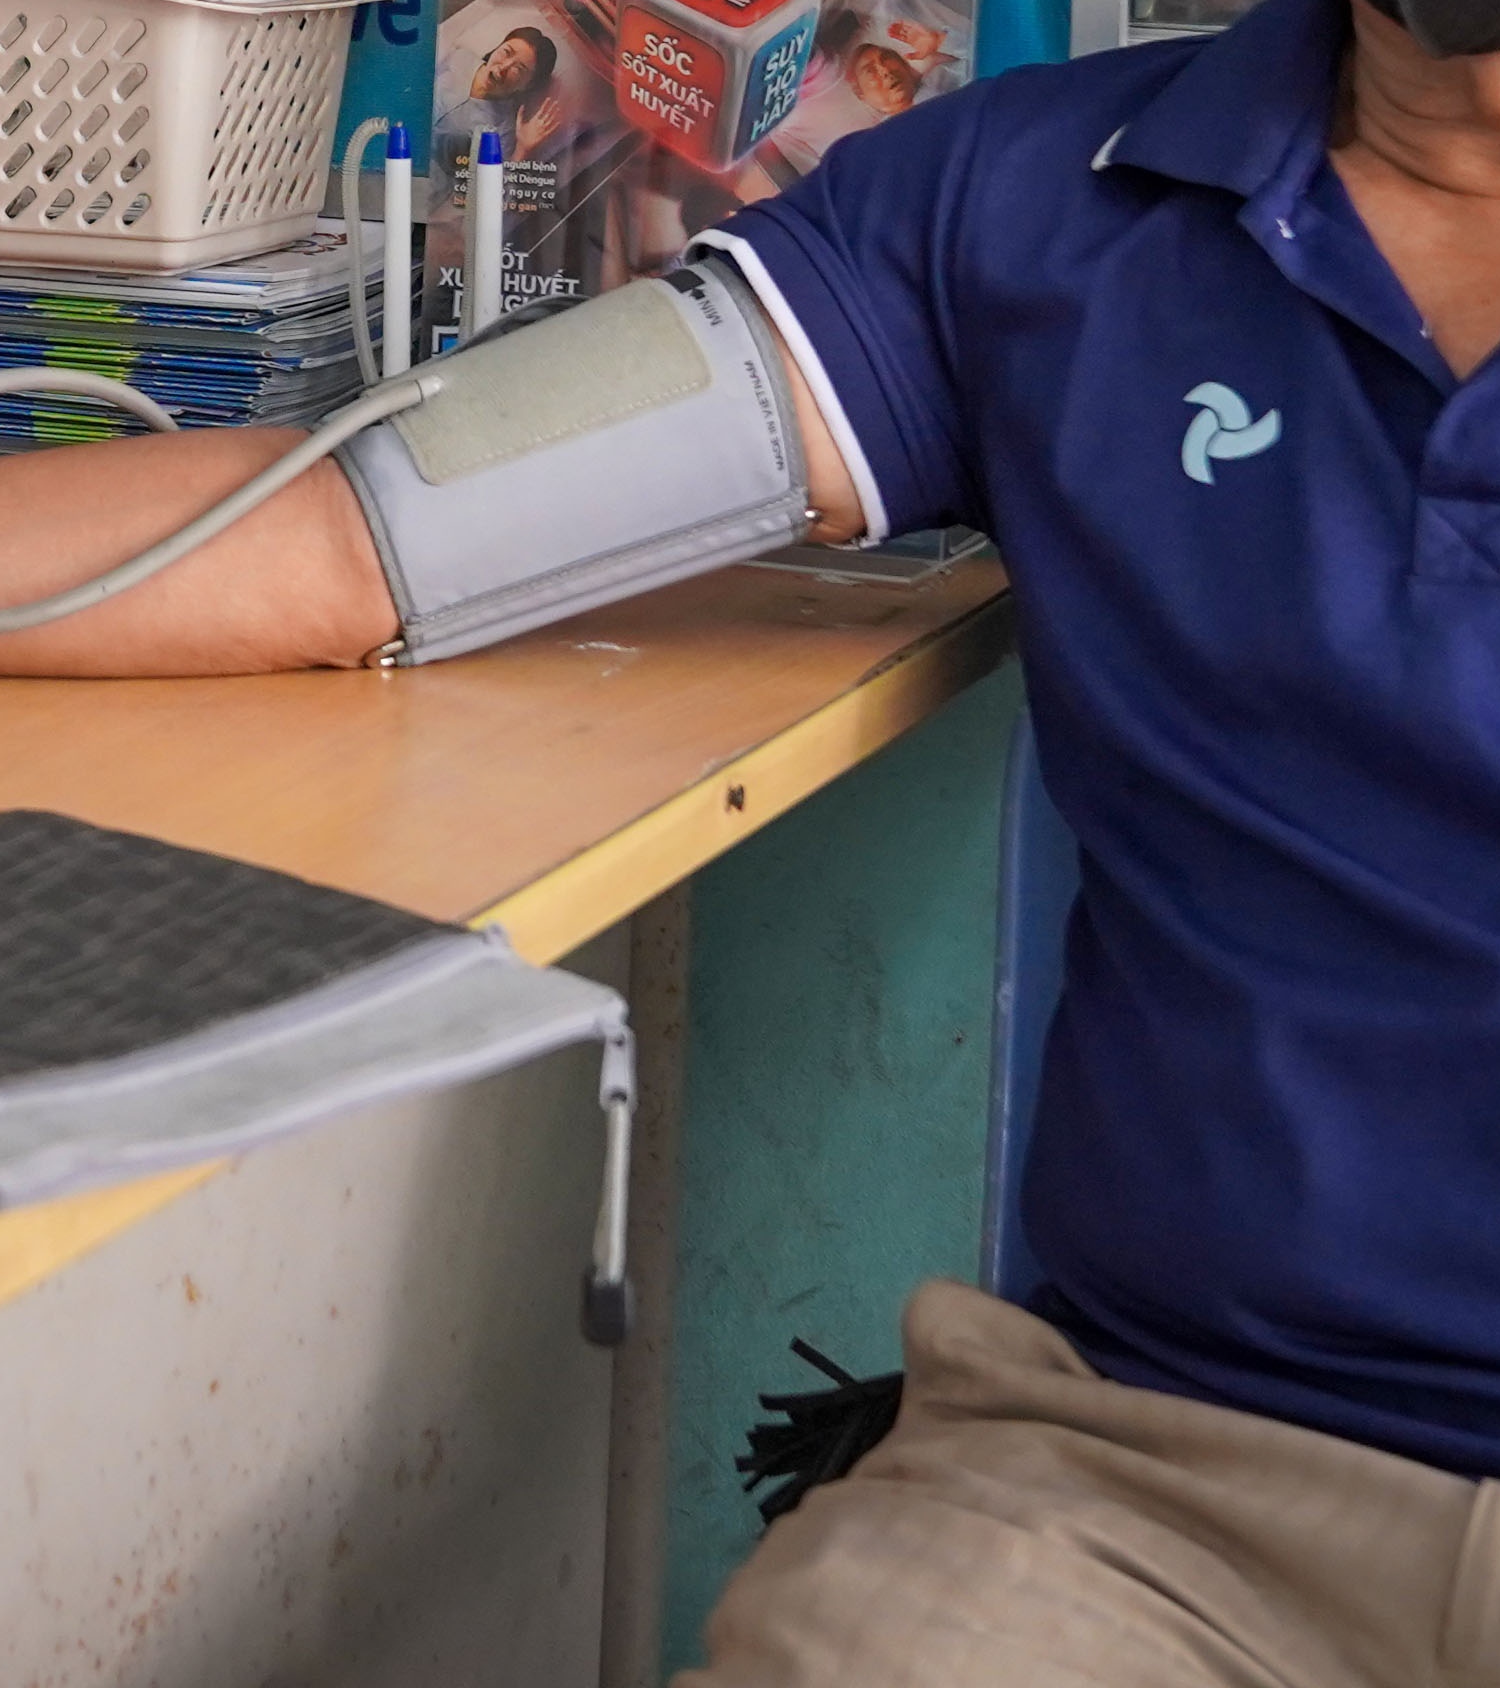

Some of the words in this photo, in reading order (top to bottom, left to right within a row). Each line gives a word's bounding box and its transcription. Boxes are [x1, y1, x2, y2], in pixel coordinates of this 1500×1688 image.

[644, 33, 694, 76] SỐC
[764, 28, 809, 81] SUY
[621, 51, 658, 84] SỐT
[658, 73, 714, 118] XUẤT
[631, 83, 695, 134] HUYẾT
[764, 60, 796, 105] HÔ
[750, 88, 795, 141] HẤP
